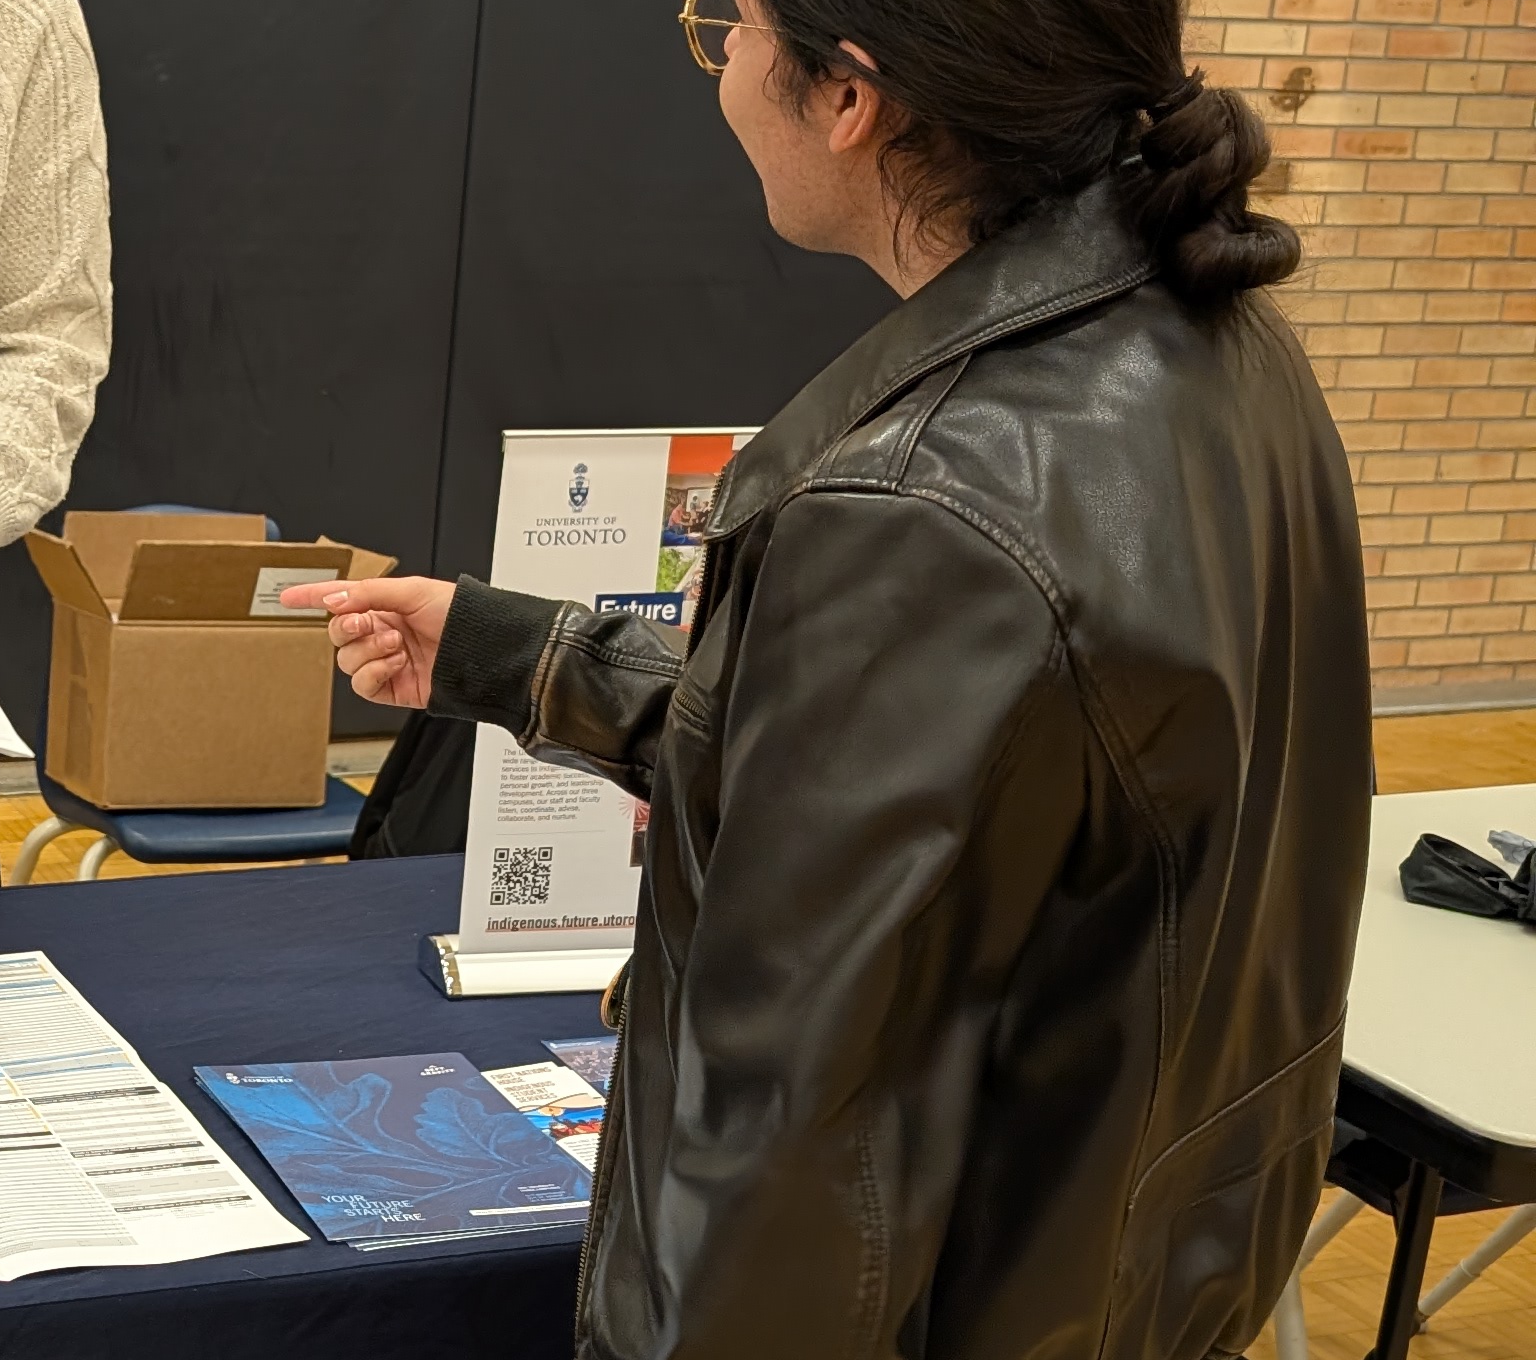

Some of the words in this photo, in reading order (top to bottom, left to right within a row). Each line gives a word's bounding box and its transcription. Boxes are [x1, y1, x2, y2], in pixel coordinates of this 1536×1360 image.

[536, 517, 600, 527] UNIVERSITY
[603, 517, 617, 525] OF
[522, 528, 627, 546] TORONTO
[600, 600, 677, 621] Fture
[487, 915, 635, 931] indigenous.future.utoro
[321, 1195, 366, 1203] YOUR
[349, 1200, 414, 1210] FUTURE
[381, 1213, 426, 1223] HERE
